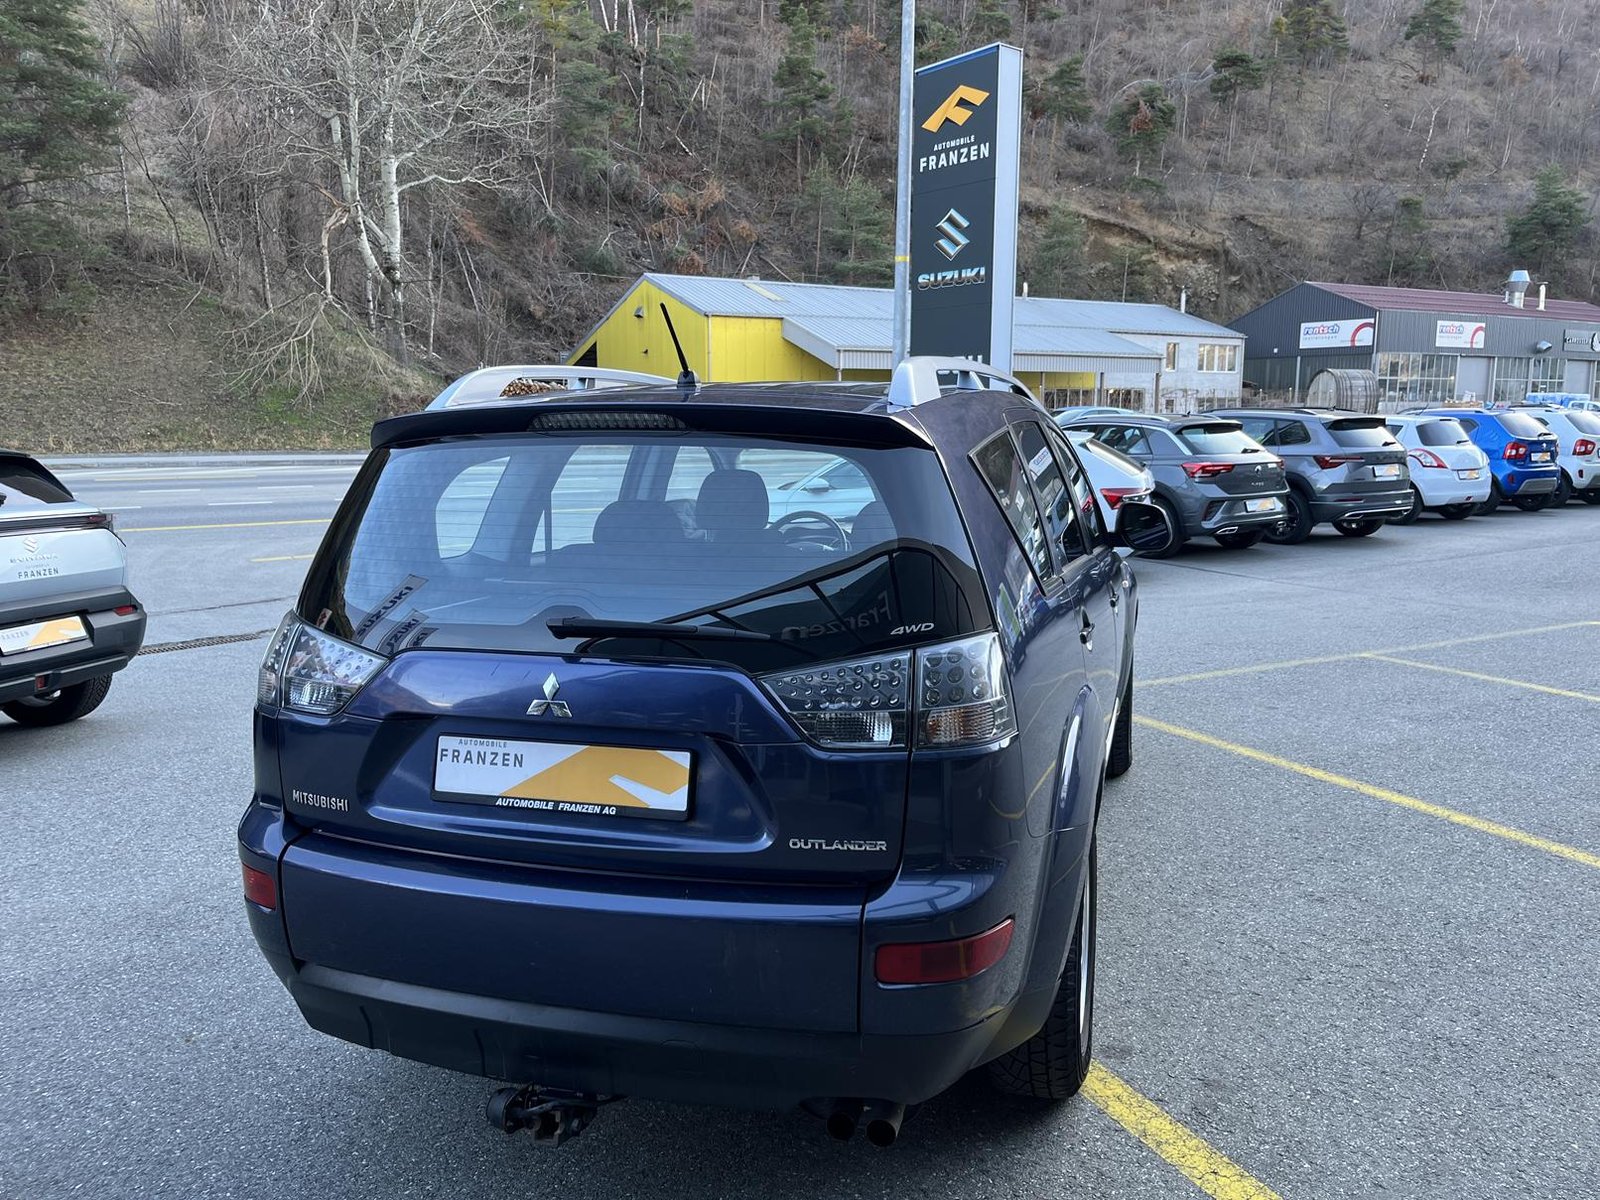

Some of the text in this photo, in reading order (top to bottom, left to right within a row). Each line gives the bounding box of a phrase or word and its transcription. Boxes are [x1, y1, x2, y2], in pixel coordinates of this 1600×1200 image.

[933, 134, 975, 151] AUTOMOBILE
[919, 142, 990, 173] FRANZEN
[918, 267, 985, 290] SUZUKI
[1303, 323, 1340, 336] rentsch
[18, 568, 59, 579] FRANZEN
[356, 585, 413, 638] SUZUKI
[890, 622, 935, 636] 4WD
[457, 738, 508, 748] AUTOMOBILE
[439, 748, 524, 768] FRANZEN
[292, 789, 349, 812] MITSUBISHI
[495, 797, 616, 815] AUTOMOBILE FRANZEN AG
[789, 838, 887, 851] OUTLANDER
